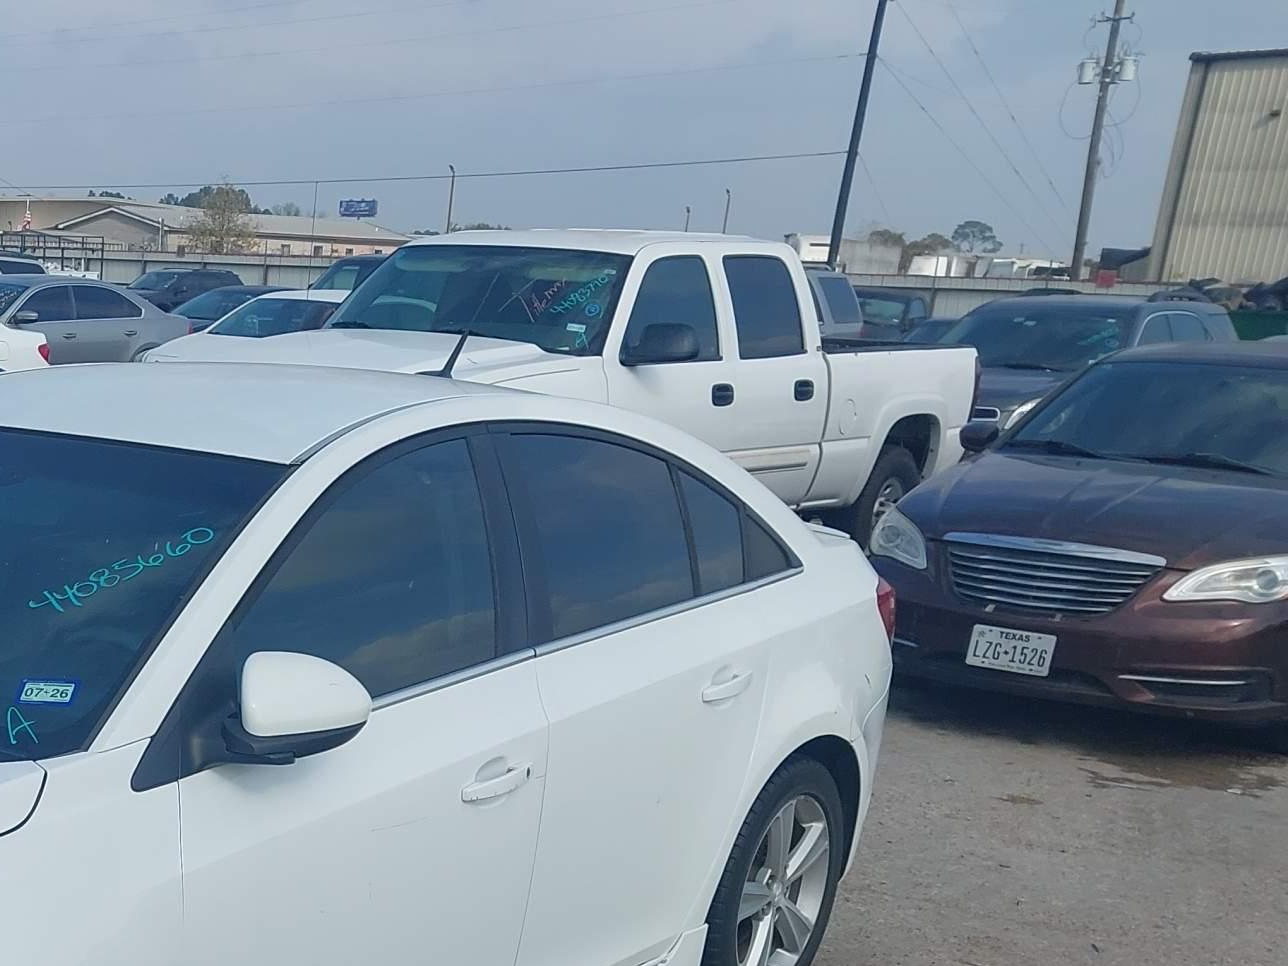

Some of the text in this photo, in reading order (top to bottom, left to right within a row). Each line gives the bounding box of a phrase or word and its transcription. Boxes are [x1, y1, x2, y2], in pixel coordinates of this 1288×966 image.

[28, 527, 214, 613] 44085660
[999, 631, 1031, 643] TEXAS
[7, 706, 39, 744] A
